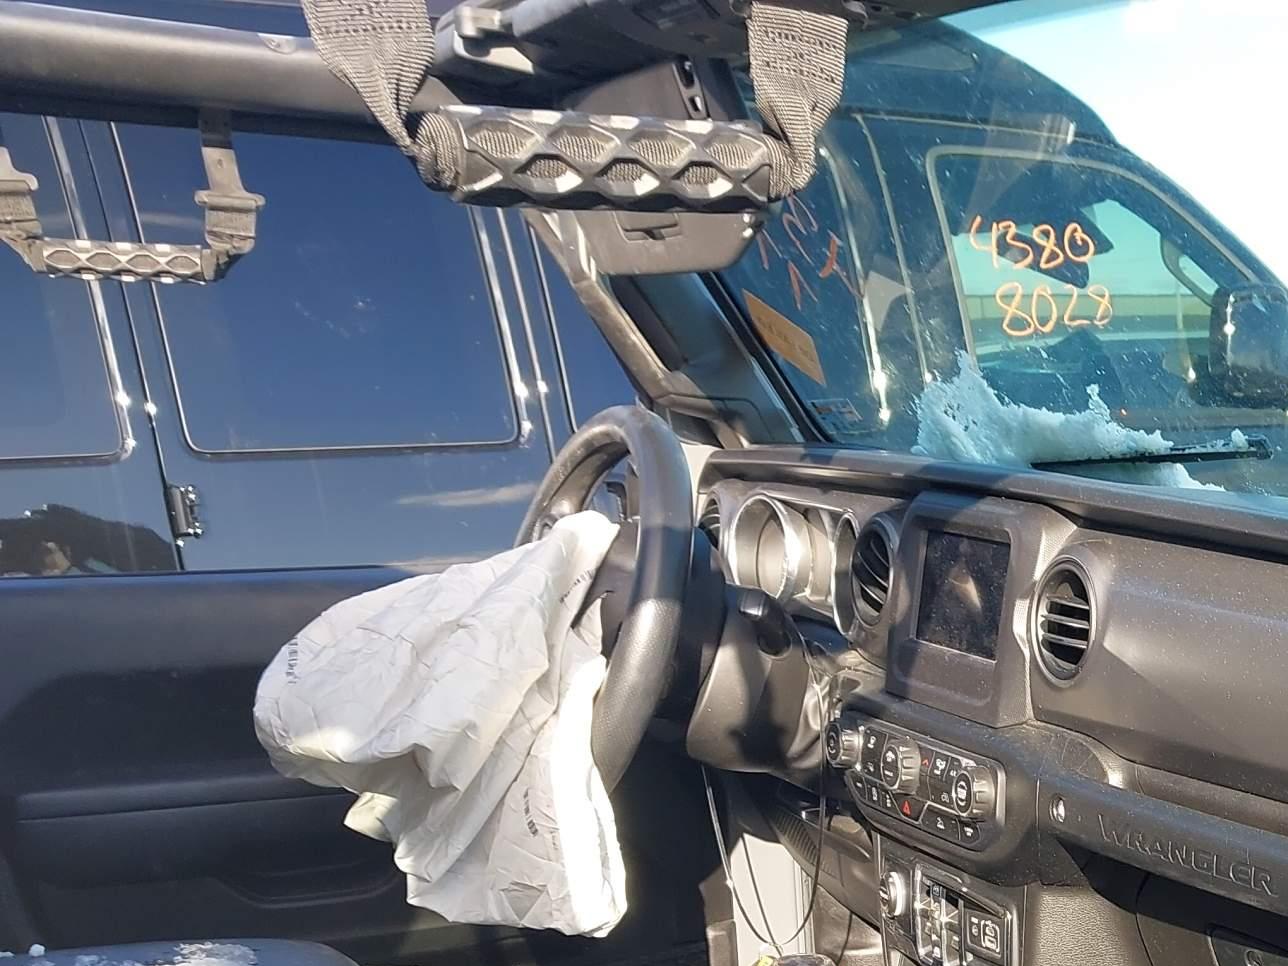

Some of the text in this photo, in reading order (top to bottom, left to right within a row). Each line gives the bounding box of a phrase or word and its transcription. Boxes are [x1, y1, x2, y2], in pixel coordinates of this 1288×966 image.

[969, 215, 1096, 269] 4380
[996, 281, 1113, 337] 8028
[1096, 813, 1279, 898] WRANGLER
